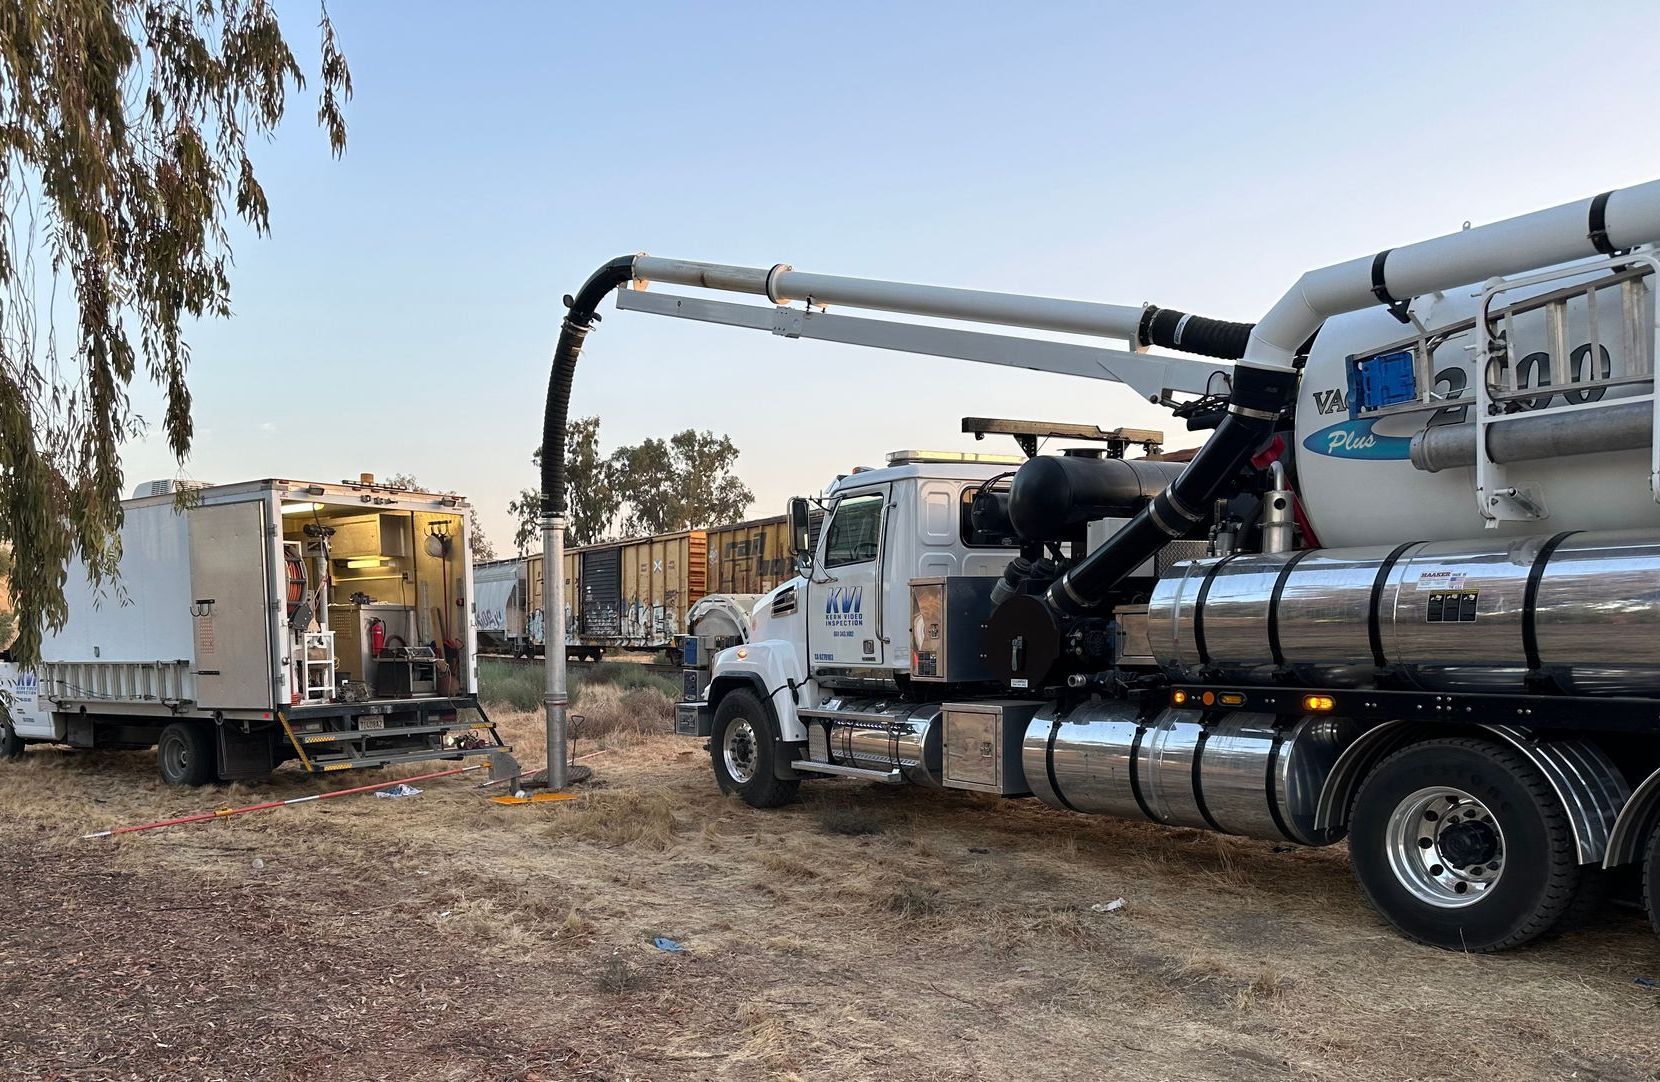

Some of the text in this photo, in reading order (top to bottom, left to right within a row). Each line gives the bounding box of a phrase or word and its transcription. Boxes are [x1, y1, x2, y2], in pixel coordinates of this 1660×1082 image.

[1313, 388, 1350, 415] VA
[1328, 430, 1376, 454] Plus
[826, 586, 863, 613] KVI
